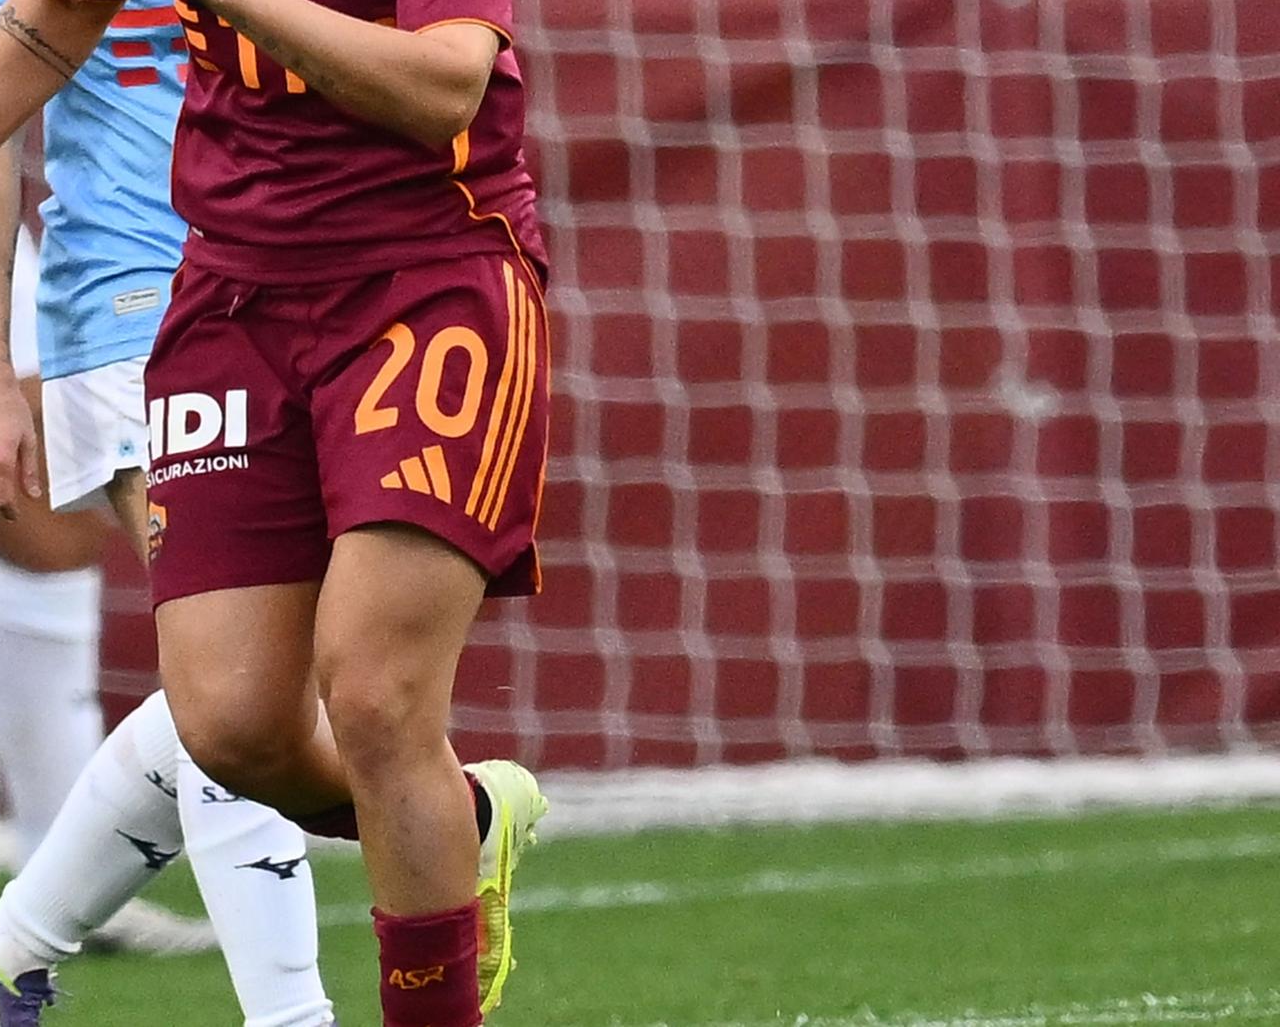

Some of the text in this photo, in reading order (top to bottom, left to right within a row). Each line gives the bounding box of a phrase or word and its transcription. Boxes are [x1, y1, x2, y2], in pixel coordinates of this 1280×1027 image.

[354, 322, 488, 438] 20
[146, 454, 249, 488] SICURAZIONI
[389, 965, 444, 990] ASR
